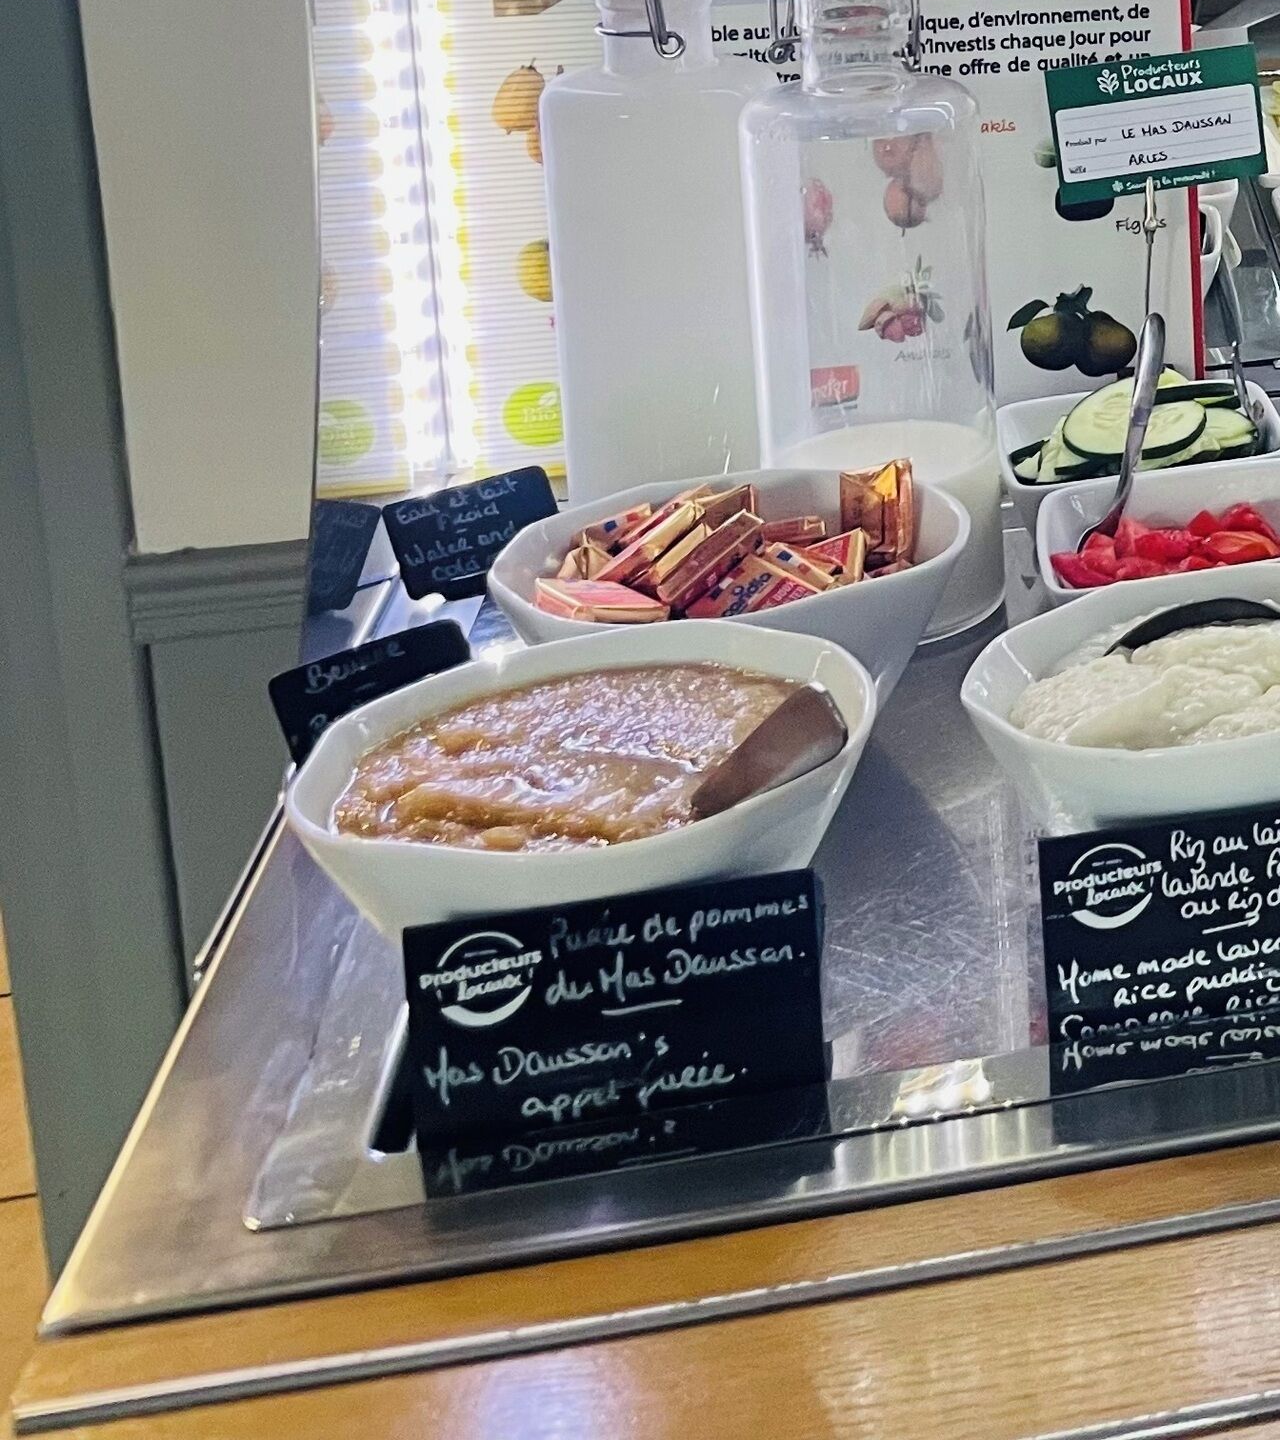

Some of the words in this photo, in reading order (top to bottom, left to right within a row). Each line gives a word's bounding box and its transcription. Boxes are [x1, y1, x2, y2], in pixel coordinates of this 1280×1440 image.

[1127, 3, 1150, 21] de
[1000, 32, 1066, 54] chaque
[1069, 30, 1106, 50] jour
[1109, 28, 1151, 47] pour
[958, 57, 1001, 76] offre
[1007, 56, 1031, 74] de
[1121, 59, 1201, 79] Producteurs
[1122, 70, 1203, 95] LOCAUX
[1121, 126, 1136, 140] LE
[1171, 113, 1232, 134] DAUSSAN
[1128, 151, 1169, 166] ARLES
[1170, 828, 1206, 873] Riz
[1213, 830, 1248, 855] au
[1053, 861, 1162, 896] Producteurs
[643, 912, 682, 946] de
[687, 892, 808, 942] pommes
[1180, 895, 1220, 919] au
[420, 948, 542, 990] Producteurs
[1058, 957, 1132, 1005] Home
[1136, 944, 1212, 977] made
